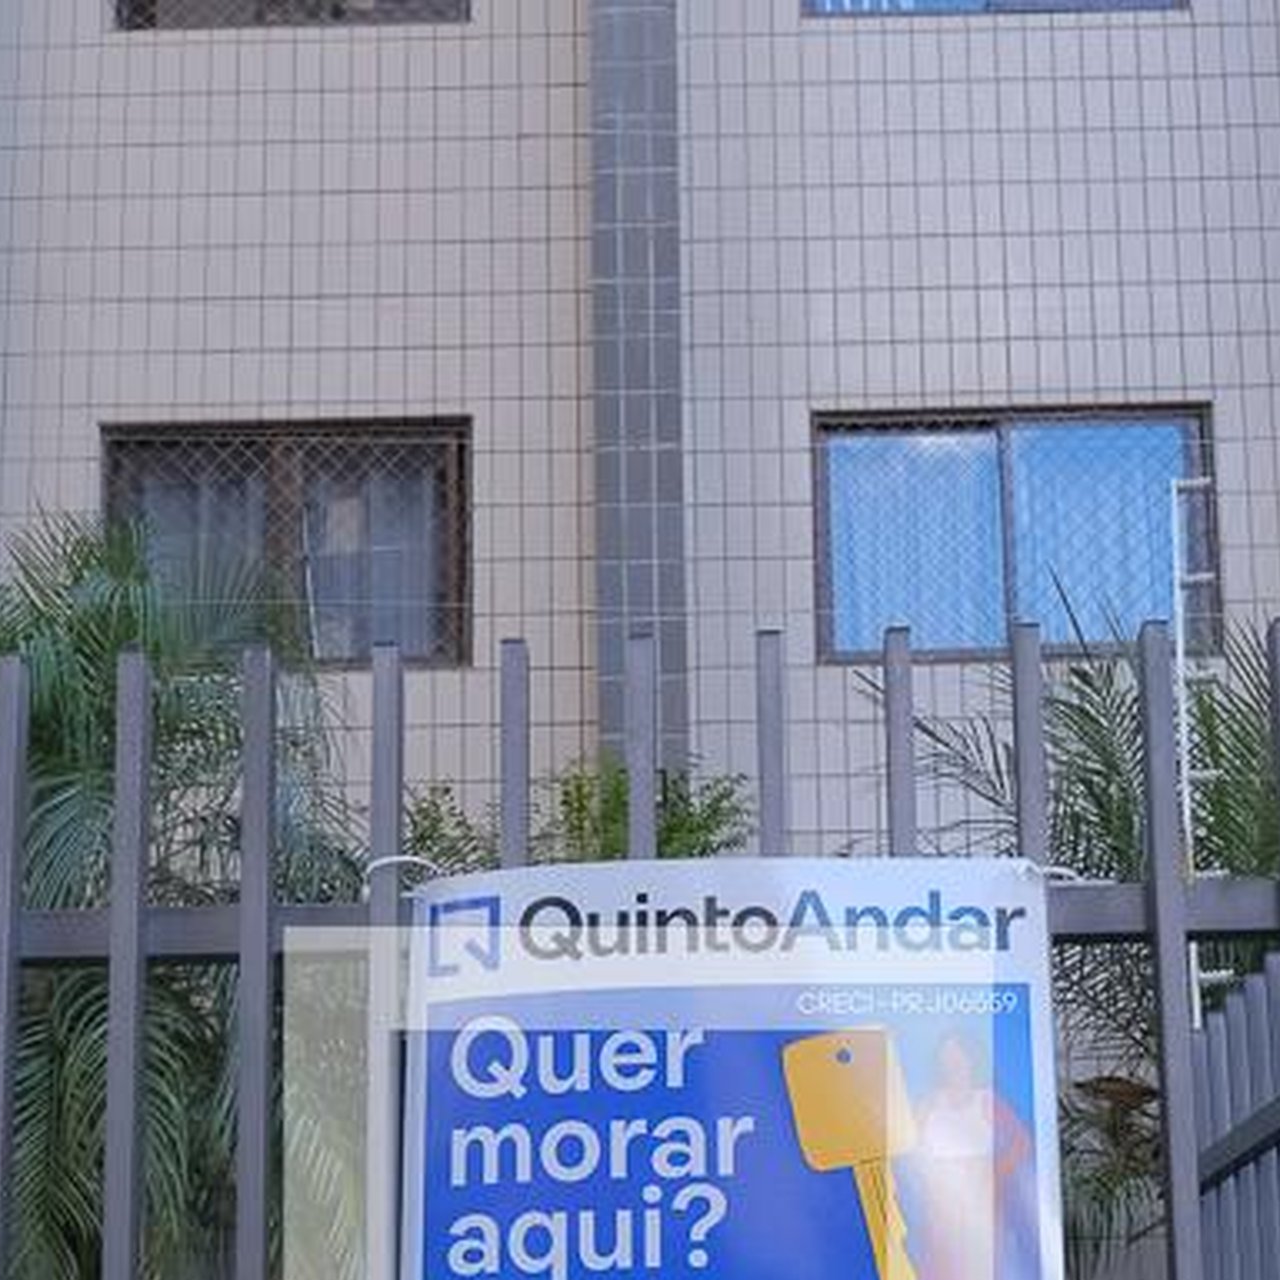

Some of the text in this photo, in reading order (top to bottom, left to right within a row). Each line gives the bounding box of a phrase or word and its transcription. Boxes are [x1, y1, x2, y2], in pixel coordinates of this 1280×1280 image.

[519, 890, 1025, 961] QuintoAndar
[450, 1015, 706, 1100] Quer
[449, 1112, 755, 1187] morar
